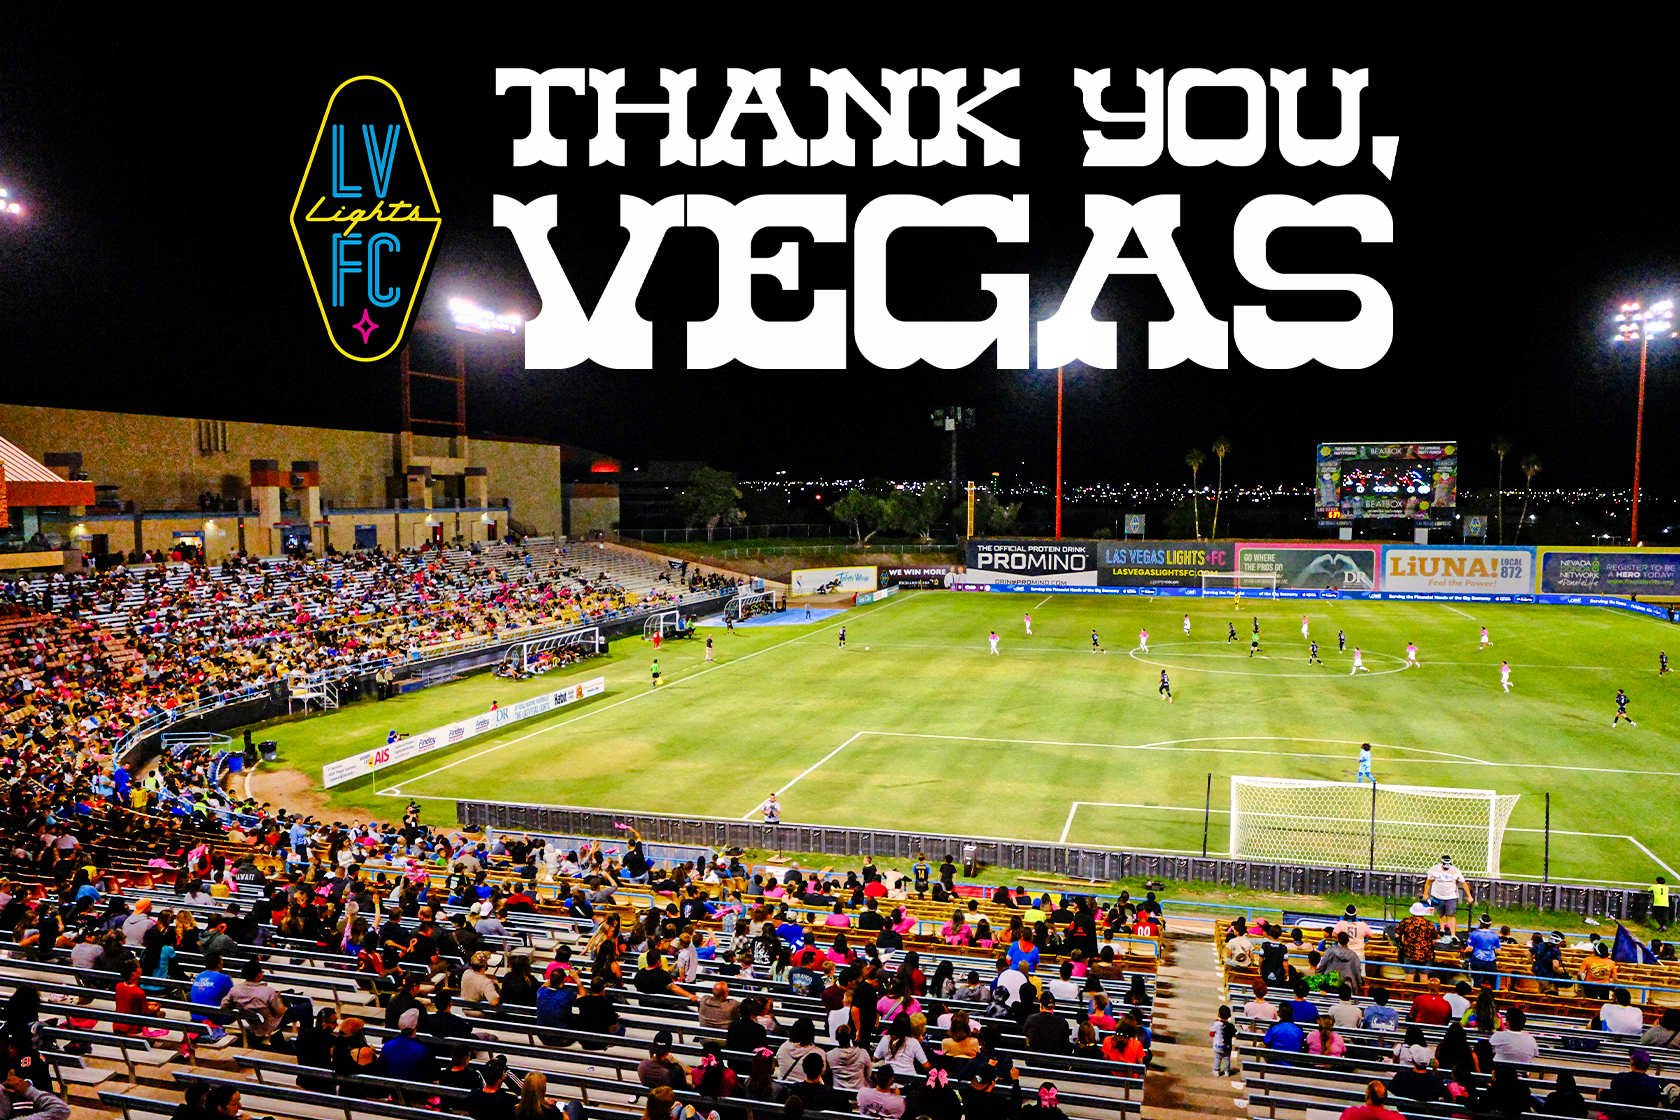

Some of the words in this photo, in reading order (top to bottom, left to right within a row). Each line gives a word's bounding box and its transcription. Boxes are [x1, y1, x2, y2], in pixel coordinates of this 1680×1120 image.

[978, 553, 1086, 570] PROMINO
[1106, 549, 1127, 564] LAS
[1128, 550, 1165, 565] VEGAS
[1166, 550, 1206, 566] LIGHTS
[1254, 554, 1275, 562] WHERE
[1501, 558, 1522, 566] LOCAL
[1257, 564, 1273, 572] PROS
[1390, 556, 1498, 578] LiUNA!
[1500, 566, 1522, 578] 872
[496, 708, 509, 722] DR
[374, 748, 390, 765] AIS
[1138, 926, 1150, 936] 00
